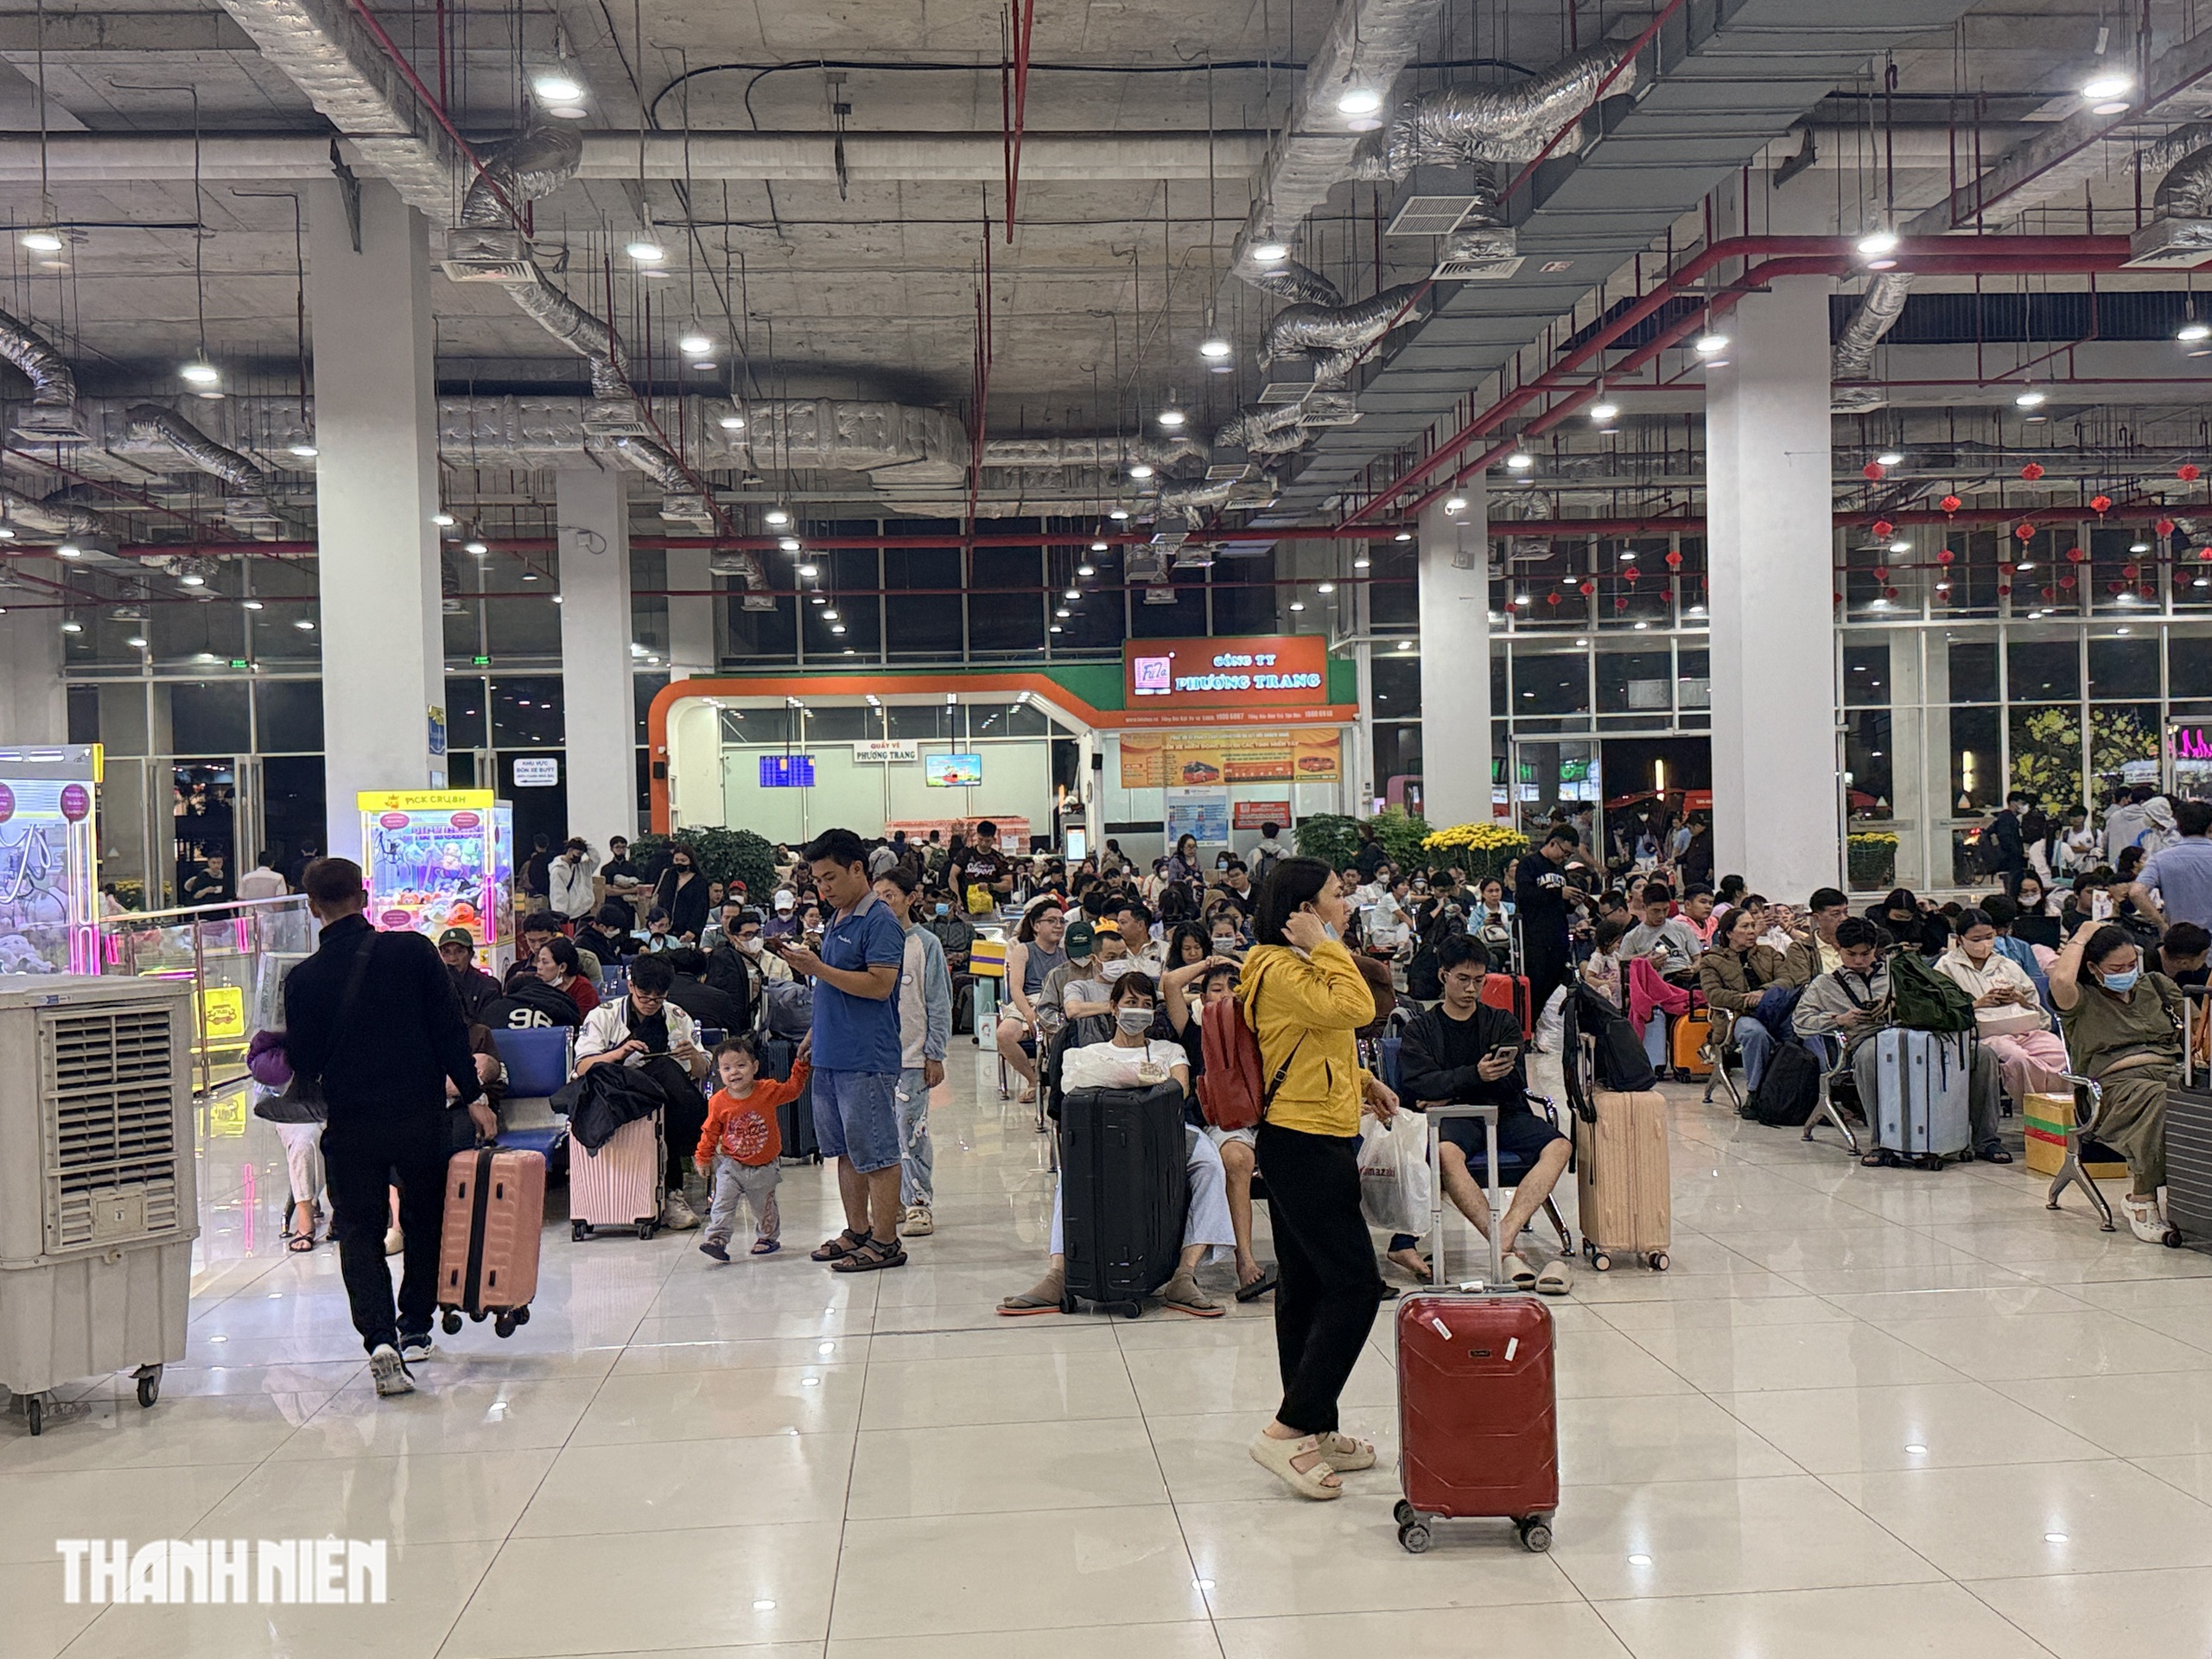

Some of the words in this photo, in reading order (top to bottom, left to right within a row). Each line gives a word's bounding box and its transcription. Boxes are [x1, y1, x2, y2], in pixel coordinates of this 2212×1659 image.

[1213, 653, 1252, 667] CÔNG
[1255, 654, 1276, 666] TY
[1175, 674, 1251, 690] PHƯƠNG
[1253, 674, 1321, 689] TRANG
[857, 750, 887, 760] PHƯƠNG
[429, 795, 466, 804] CRUSH
